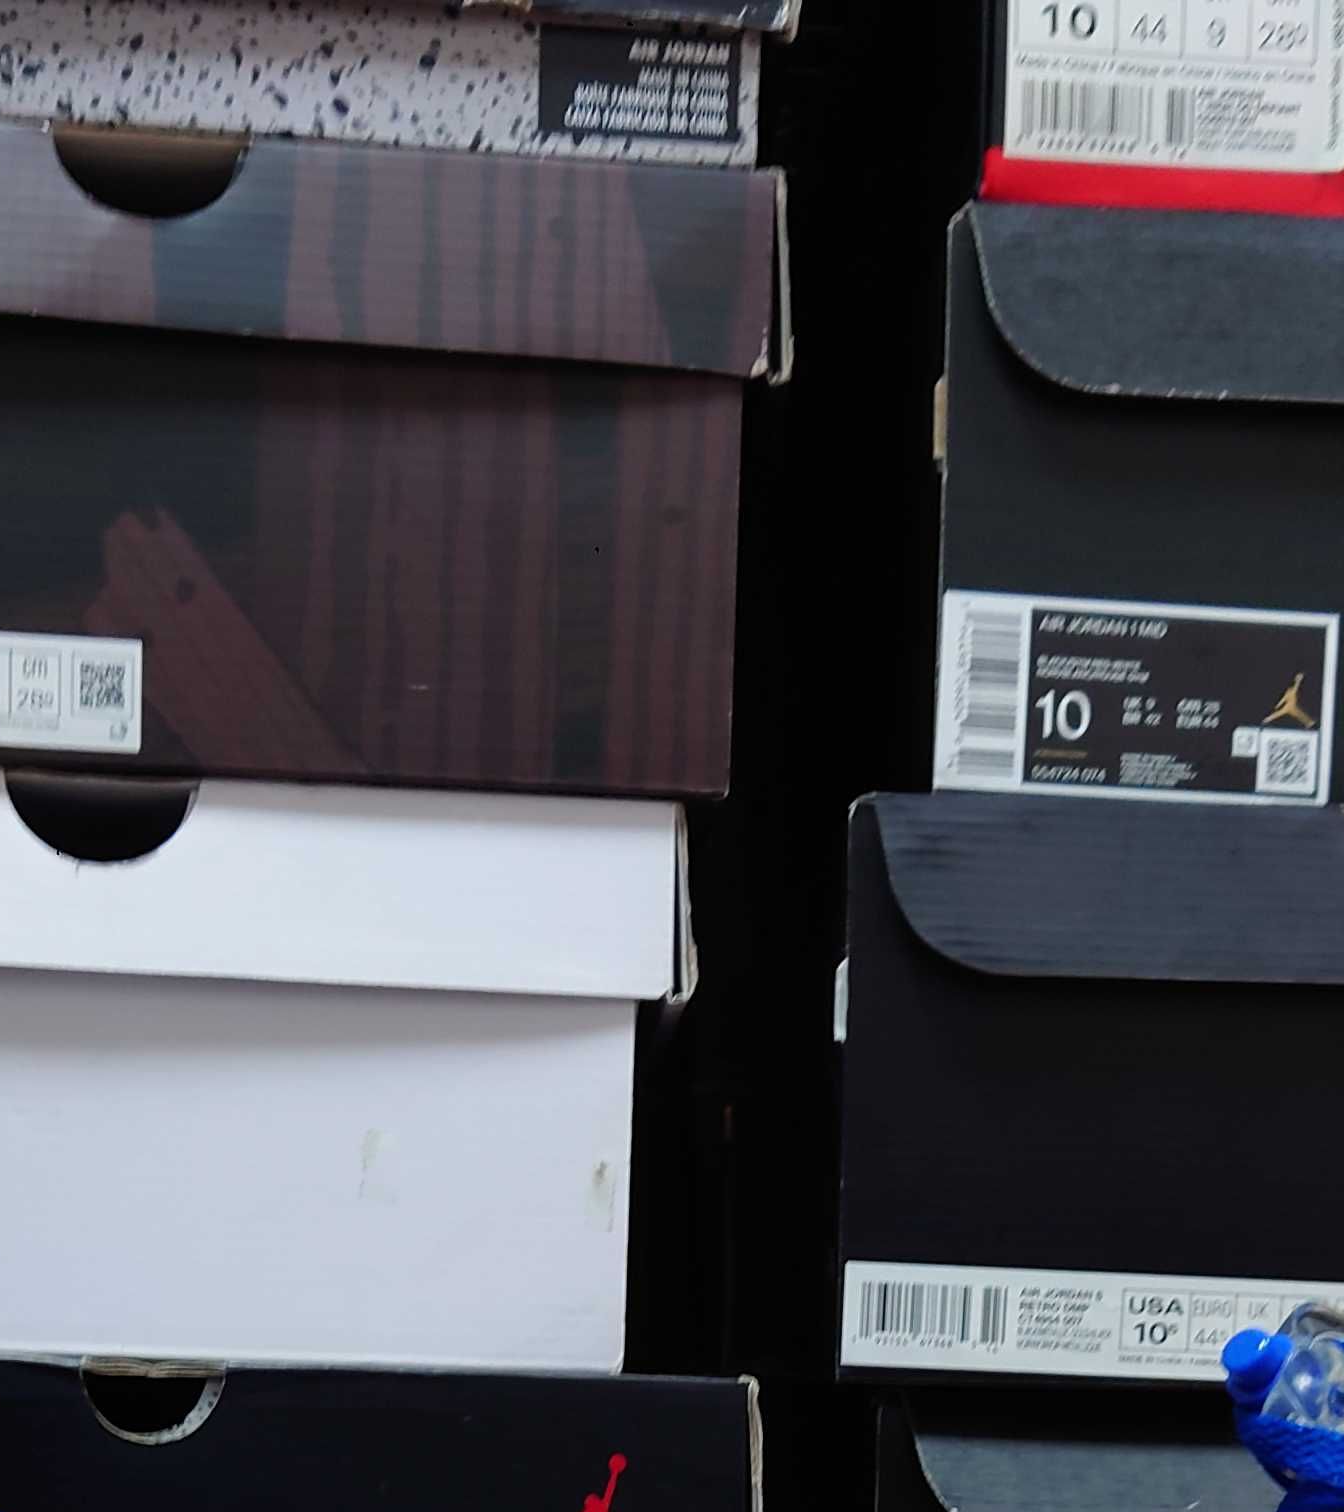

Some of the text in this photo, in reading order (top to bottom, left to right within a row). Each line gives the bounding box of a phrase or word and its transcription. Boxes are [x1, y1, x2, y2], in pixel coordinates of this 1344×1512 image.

[1041, 4, 1098, 41] 10
[1035, 688, 1092, 742] 10
[1127, 1294, 1185, 1317] USA
